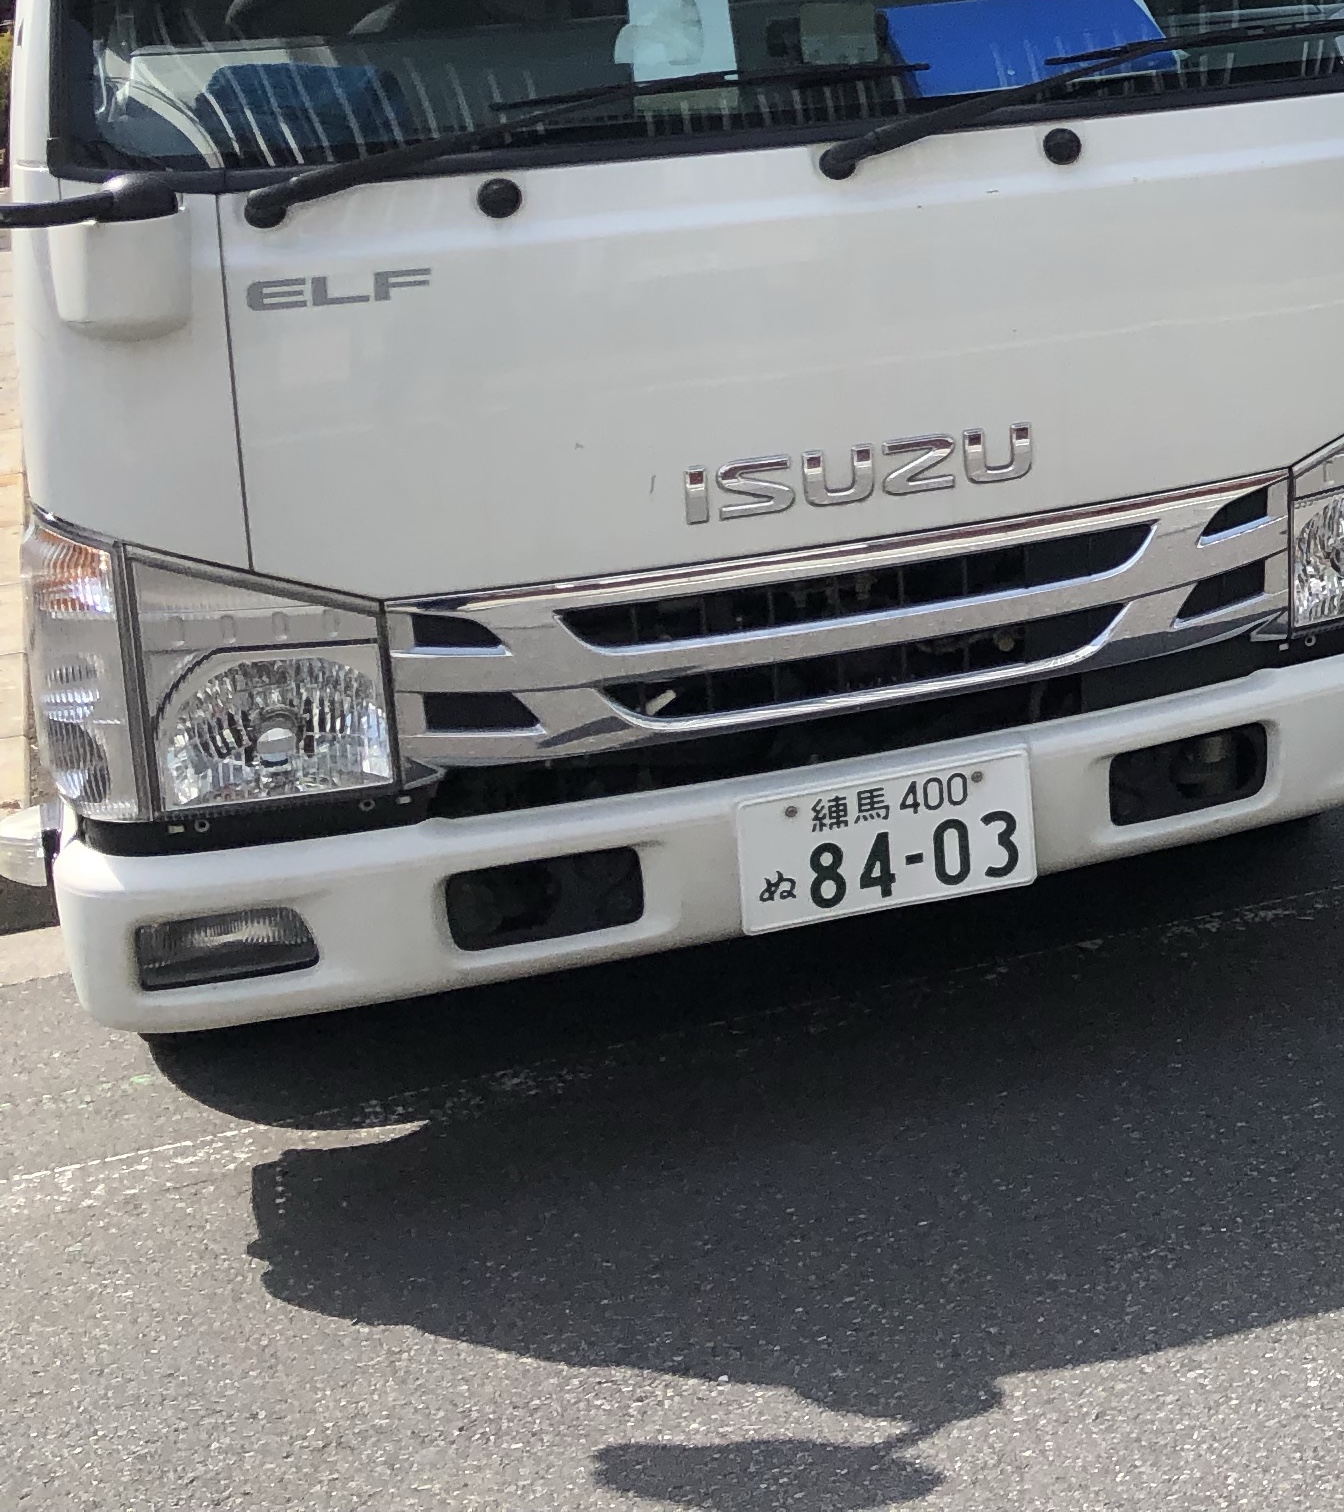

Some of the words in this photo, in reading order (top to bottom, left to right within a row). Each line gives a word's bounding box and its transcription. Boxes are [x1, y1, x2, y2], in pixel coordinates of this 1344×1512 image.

[246, 267, 431, 311] ELF
[684, 421, 1032, 526] ISUZU
[810, 786, 890, 833] 練馬
[899, 772, 968, 815] 400
[758, 869, 797, 903] ぬ
[809, 810, 1020, 909] 84-03
